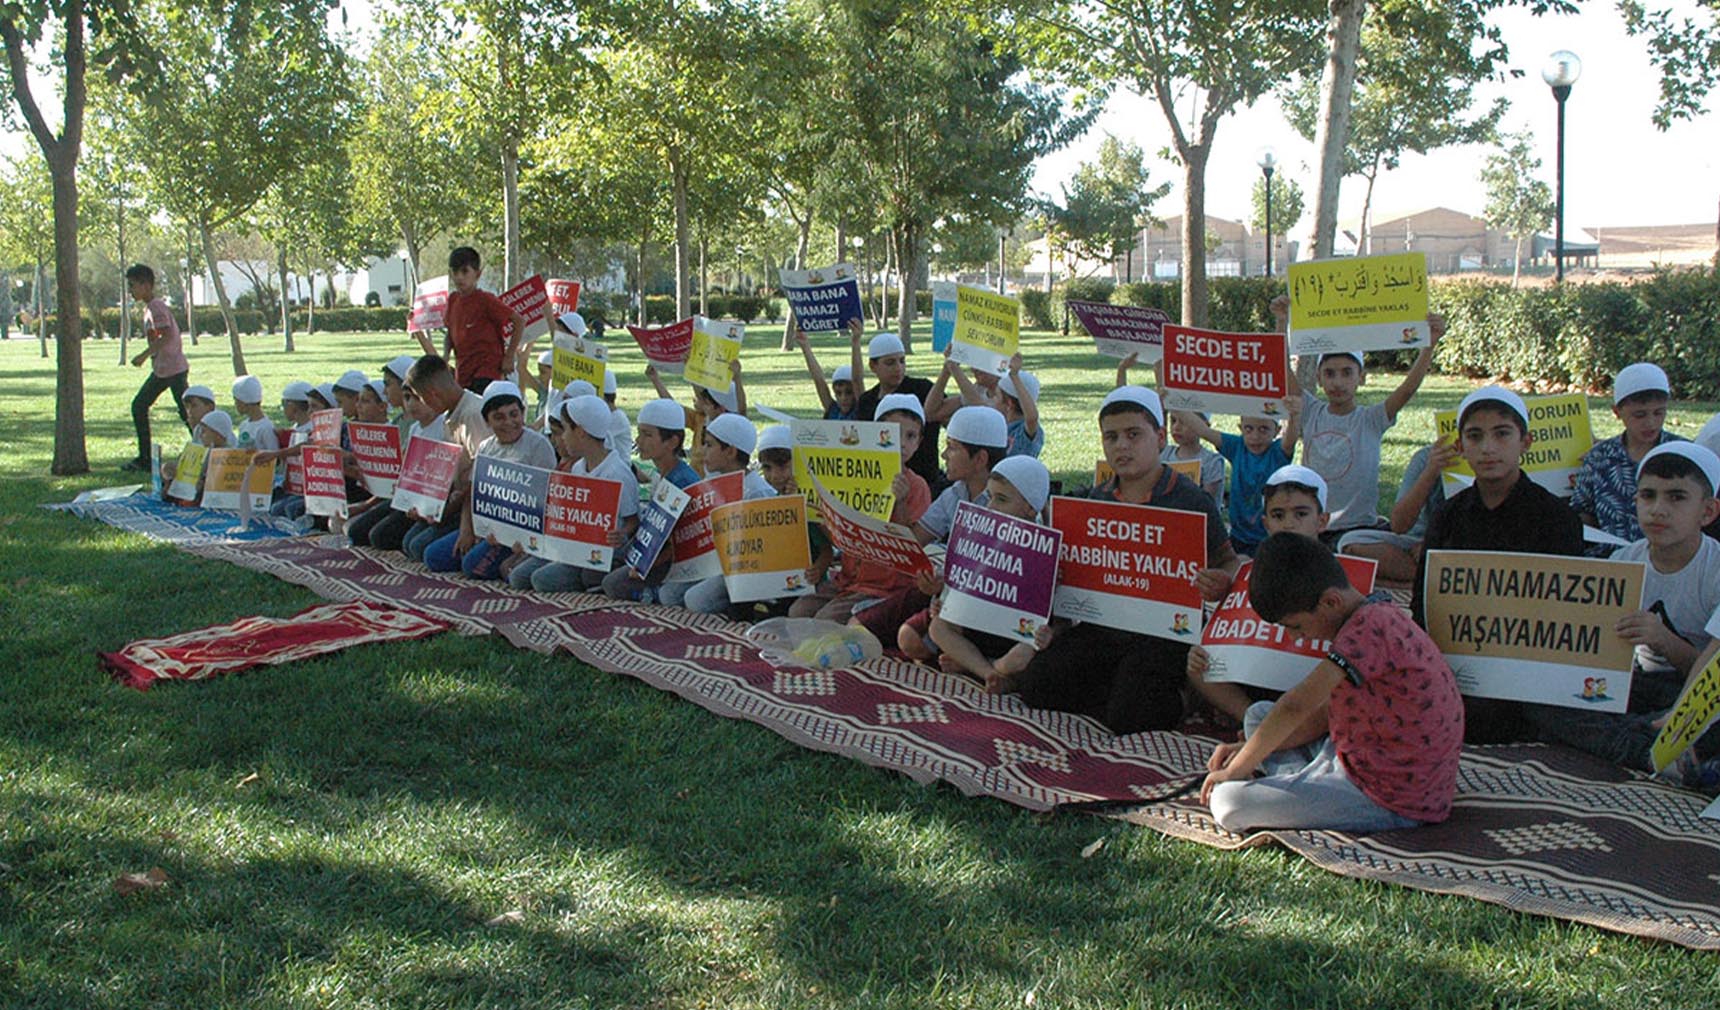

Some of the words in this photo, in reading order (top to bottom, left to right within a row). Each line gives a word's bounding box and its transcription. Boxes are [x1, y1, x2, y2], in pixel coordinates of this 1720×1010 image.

[812, 286, 848, 302] BANA
[795, 304, 839, 317] NAMAZI
[803, 319, 840, 330] ÖĞRET
[1176, 334, 1233, 360] SECDE
[1237, 341, 1266, 364] ET,
[1169, 363, 1236, 388] HUZUR
[1239, 372, 1280, 393] BUL
[486, 464, 534, 488] NAMAZ
[807, 456, 843, 478] ANNE
[846, 458, 883, 480] BANA
[478, 481, 538, 509] UYKUDAN
[575, 488, 591, 503] ET
[852, 488, 893, 515] ÖĞRET
[475, 499, 541, 531] HAYIRLIDIR
[566, 507, 612, 532] YAKLAŞ
[955, 509, 963, 525] 7
[961, 511, 997, 537] YAŞIMA
[996, 521, 1054, 556] GİRDİM
[1087, 517, 1141, 543] SECDE
[1144, 525, 1165, 545] ET
[954, 538, 1023, 577] NAMAZIMA
[1060, 544, 1131, 571] RABBİNE
[1133, 553, 1199, 587] YAKLAŞ
[949, 564, 1018, 603] BAŞLADIM
[1103, 573, 1150, 591] (ALAK-19)
[1438, 566, 1481, 596] BEN
[1486, 568, 1627, 607] NAMAZSIN
[1449, 614, 1601, 655] YAŞAYAMAM
